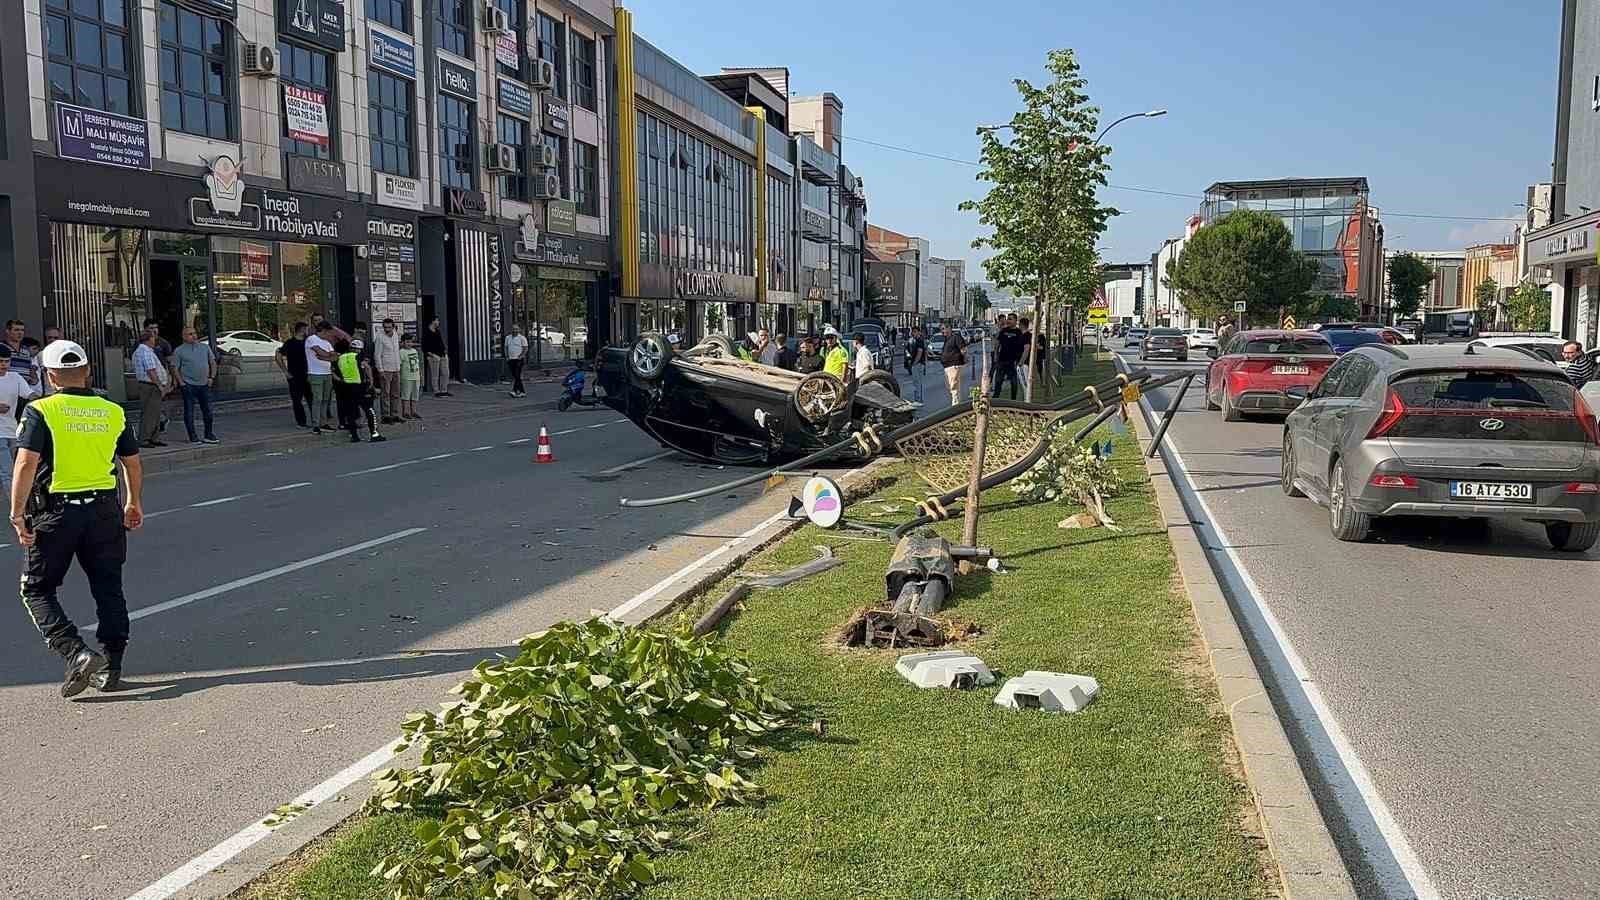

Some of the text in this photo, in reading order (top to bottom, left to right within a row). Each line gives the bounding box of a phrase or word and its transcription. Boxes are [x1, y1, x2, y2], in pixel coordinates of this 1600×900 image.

[287, 85, 324, 103] KIRALIK
[86, 127, 145, 147] MALİ MÜŞAVİR
[304, 160, 343, 178] VESTA
[1459, 483, 1528, 497] 16 ATZ 530
